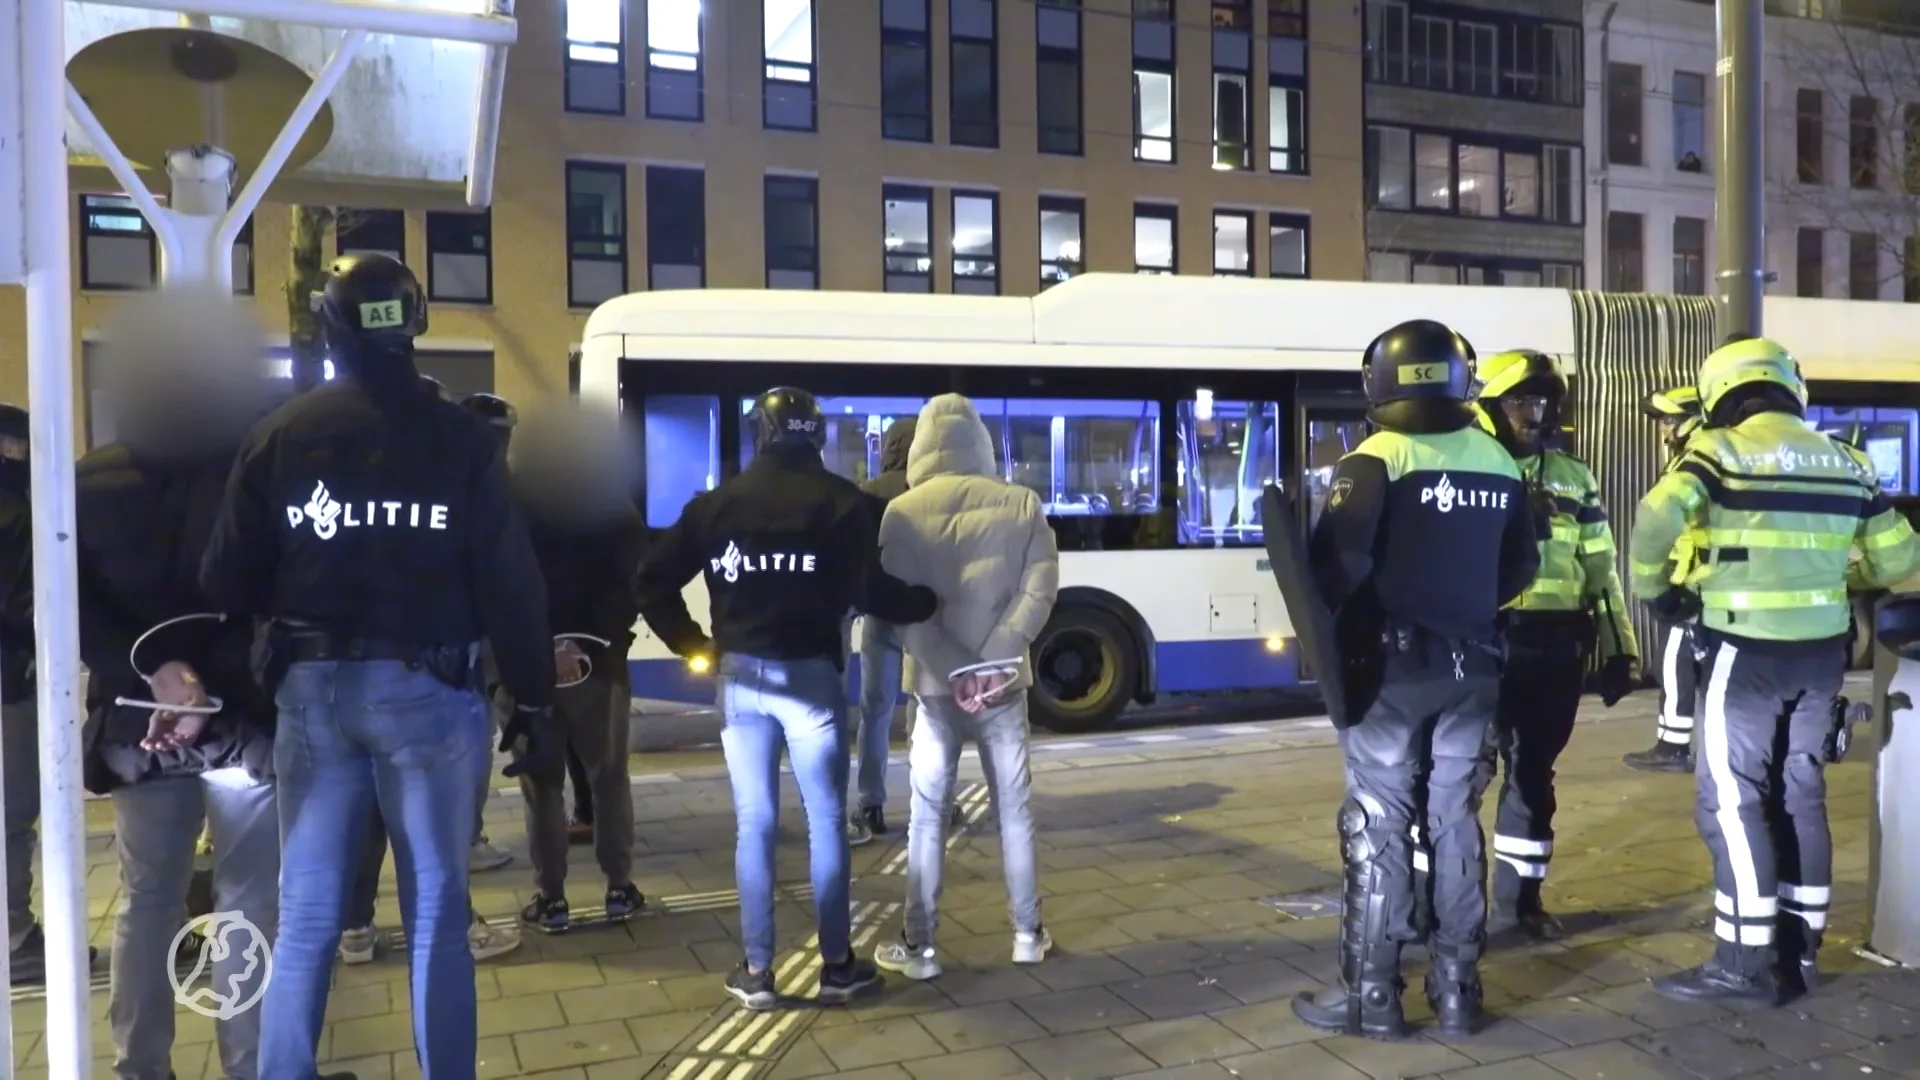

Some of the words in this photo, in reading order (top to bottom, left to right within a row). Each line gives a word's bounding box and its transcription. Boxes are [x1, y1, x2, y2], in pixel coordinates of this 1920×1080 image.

[369, 304, 397, 324] AE
[1414, 367, 1433, 380] SC
[286, 481, 448, 540] POLITIE
[1420, 473, 1509, 512] POLITIE
[710, 541, 816, 582] POLITIE
